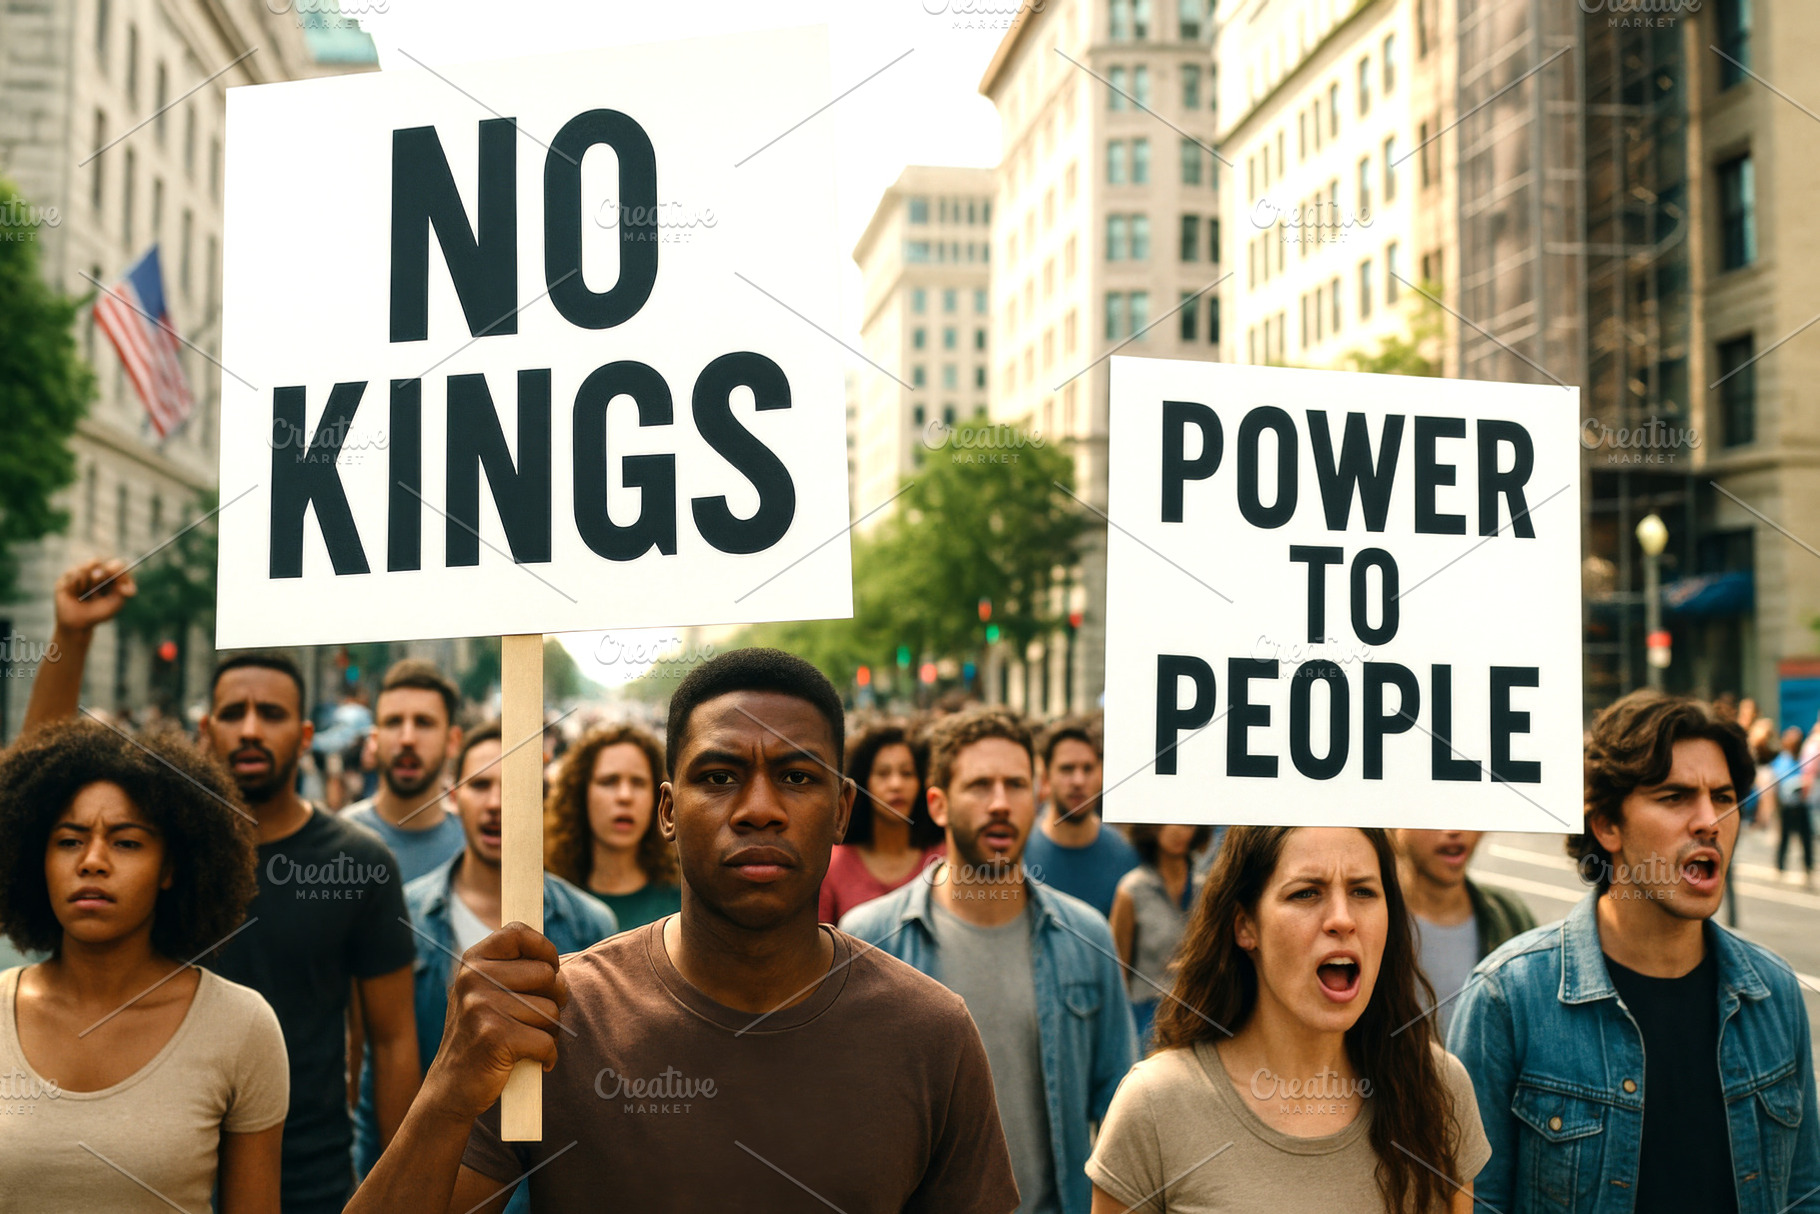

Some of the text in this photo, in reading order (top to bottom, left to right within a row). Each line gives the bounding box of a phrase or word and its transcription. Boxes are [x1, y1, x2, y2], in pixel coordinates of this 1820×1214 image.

[389, 108, 659, 343] NO
[269, 351, 797, 580] KINGS
[1161, 400, 1537, 539] POWER
[1289, 545, 1400, 646] TO
[1155, 654, 1542, 784] PEOPLE
